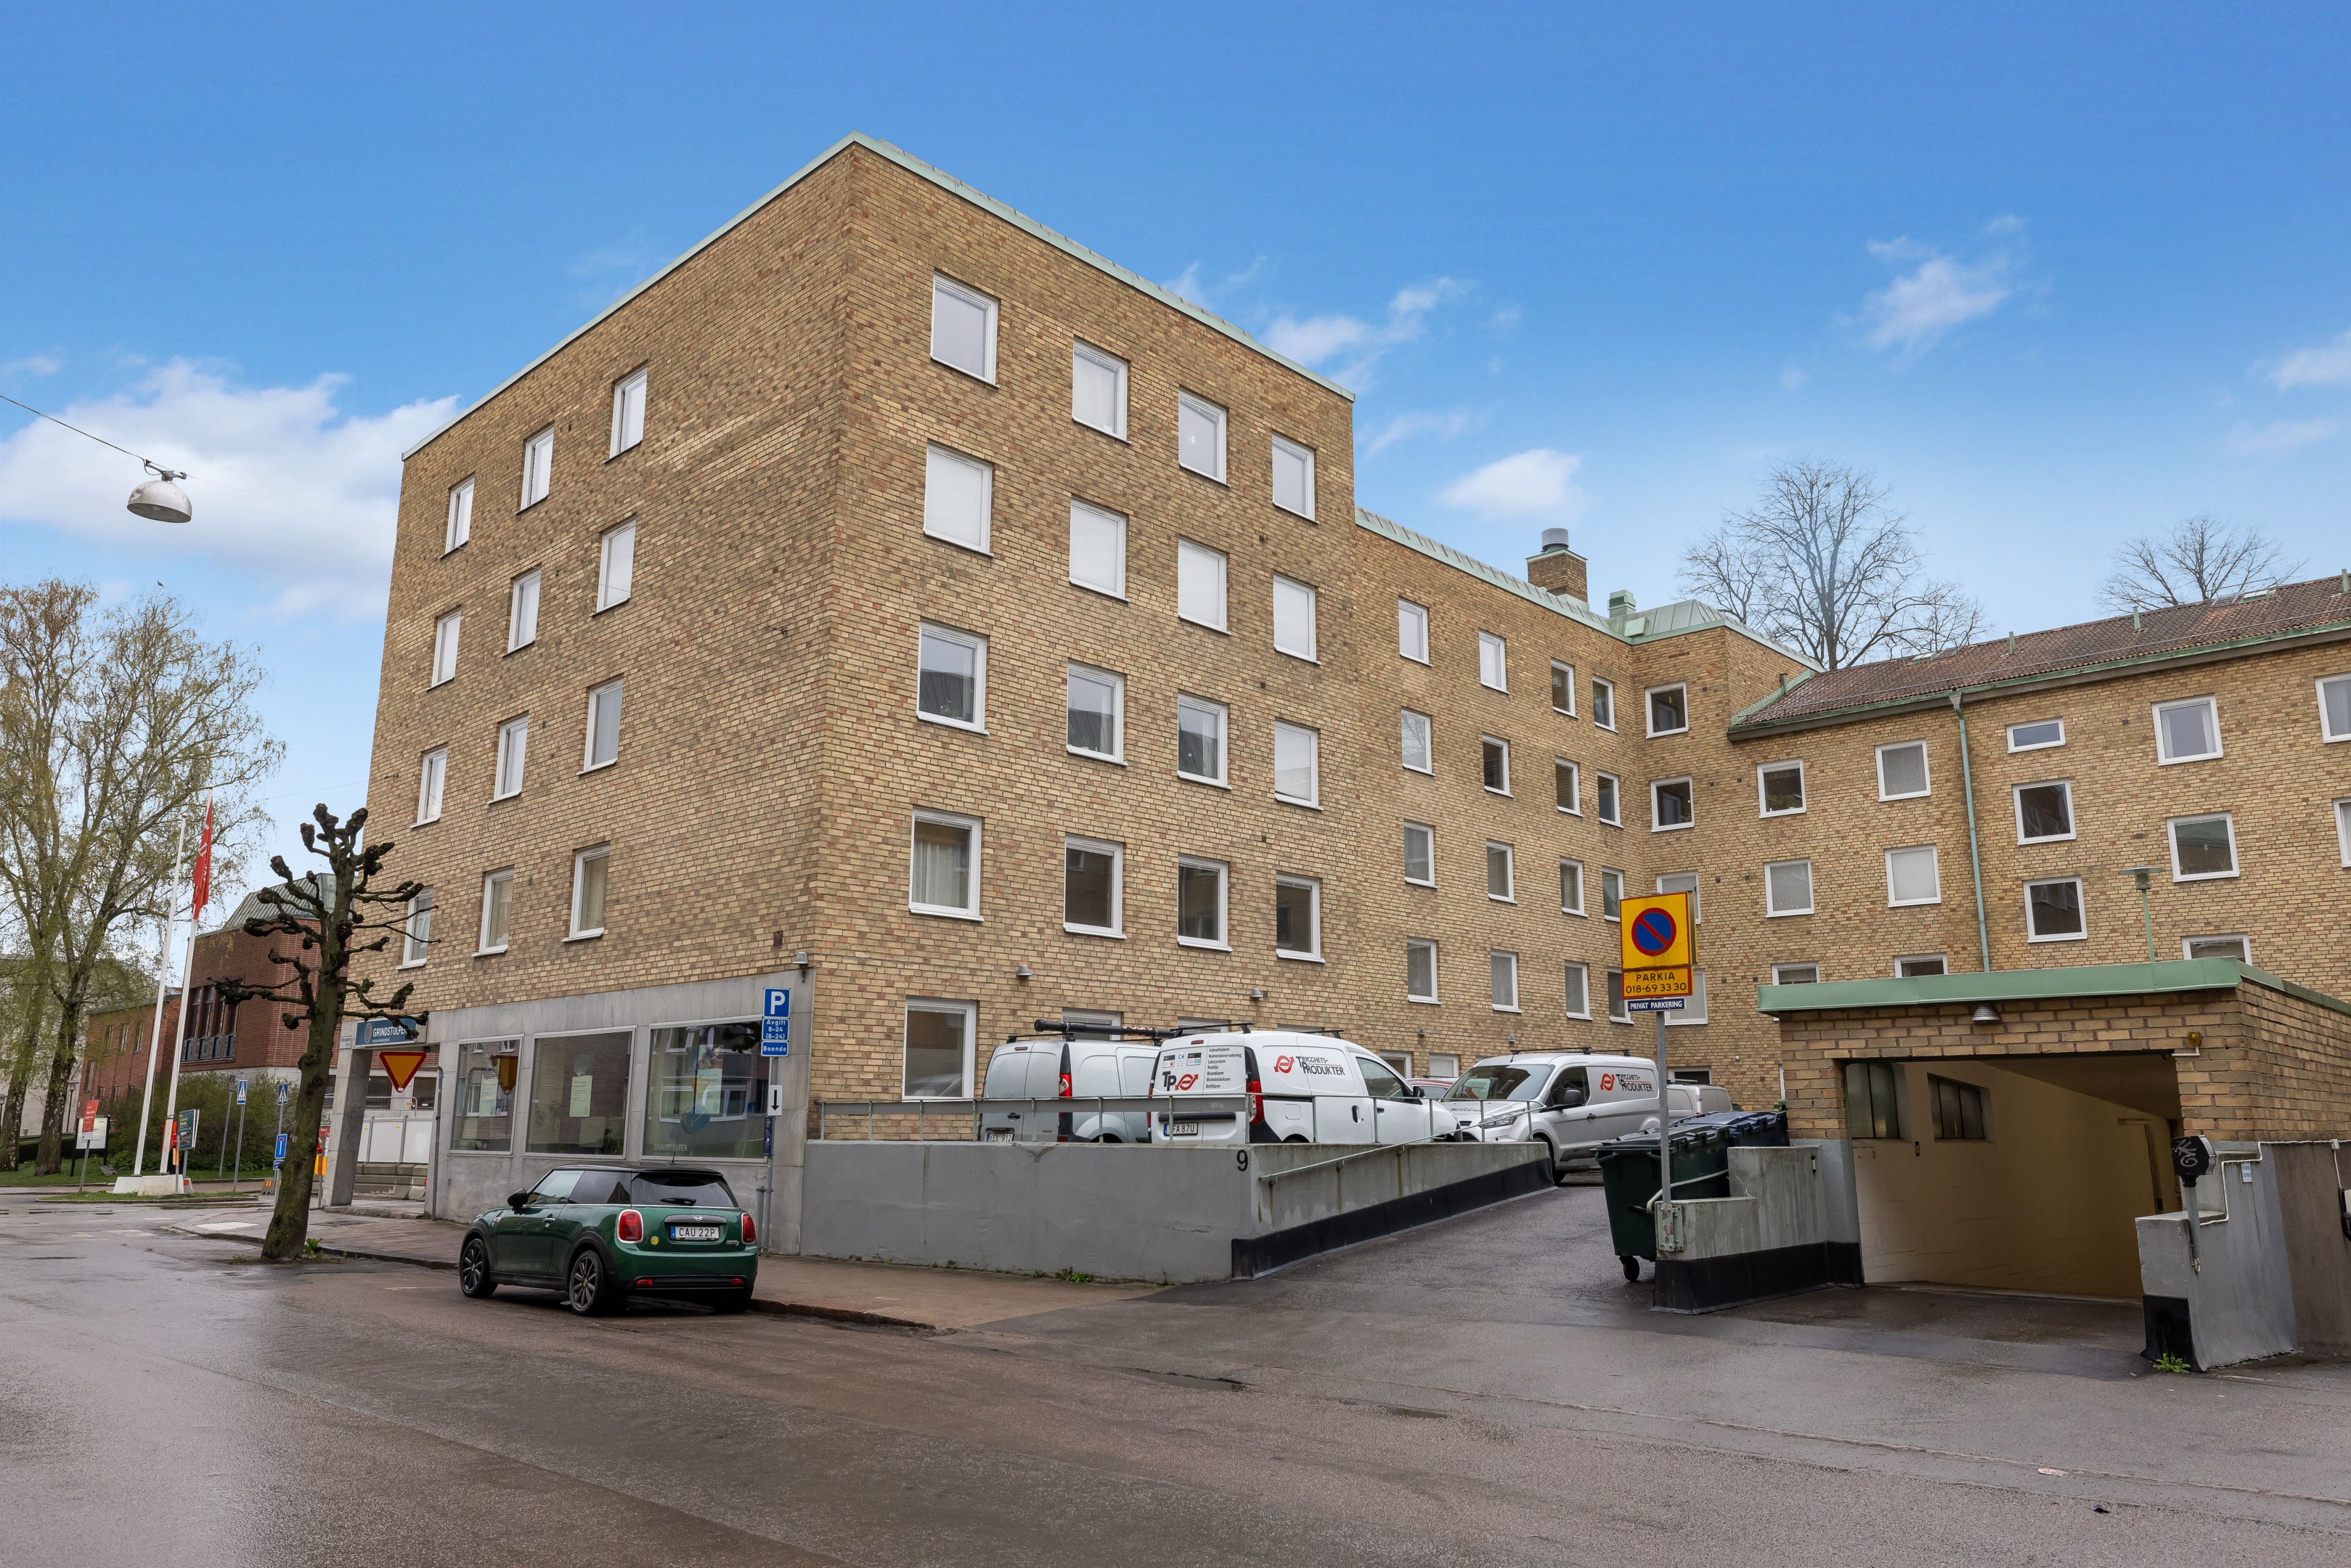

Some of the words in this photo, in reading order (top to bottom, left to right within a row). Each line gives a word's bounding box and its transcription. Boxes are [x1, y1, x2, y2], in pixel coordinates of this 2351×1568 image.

[1636, 972, 1675, 982] PARKIA
[1626, 984, 1658, 994] 018-69
[1660, 983, 1671, 992] 33
[1674, 982, 1687, 991] 30
[770, 991, 786, 1015] P
[1650, 1000, 1682, 1009] PARKERING
[1301, 1061, 1345, 1076] PRODUKTER
[1621, 1079, 1653, 1092] PRODUKTER
[1181, 1124, 1195, 1133] 87U
[1236, 1149, 1248, 1172] 9
[679, 1228, 696, 1236] CAU
[698, 1228, 715, 1237] 22P
